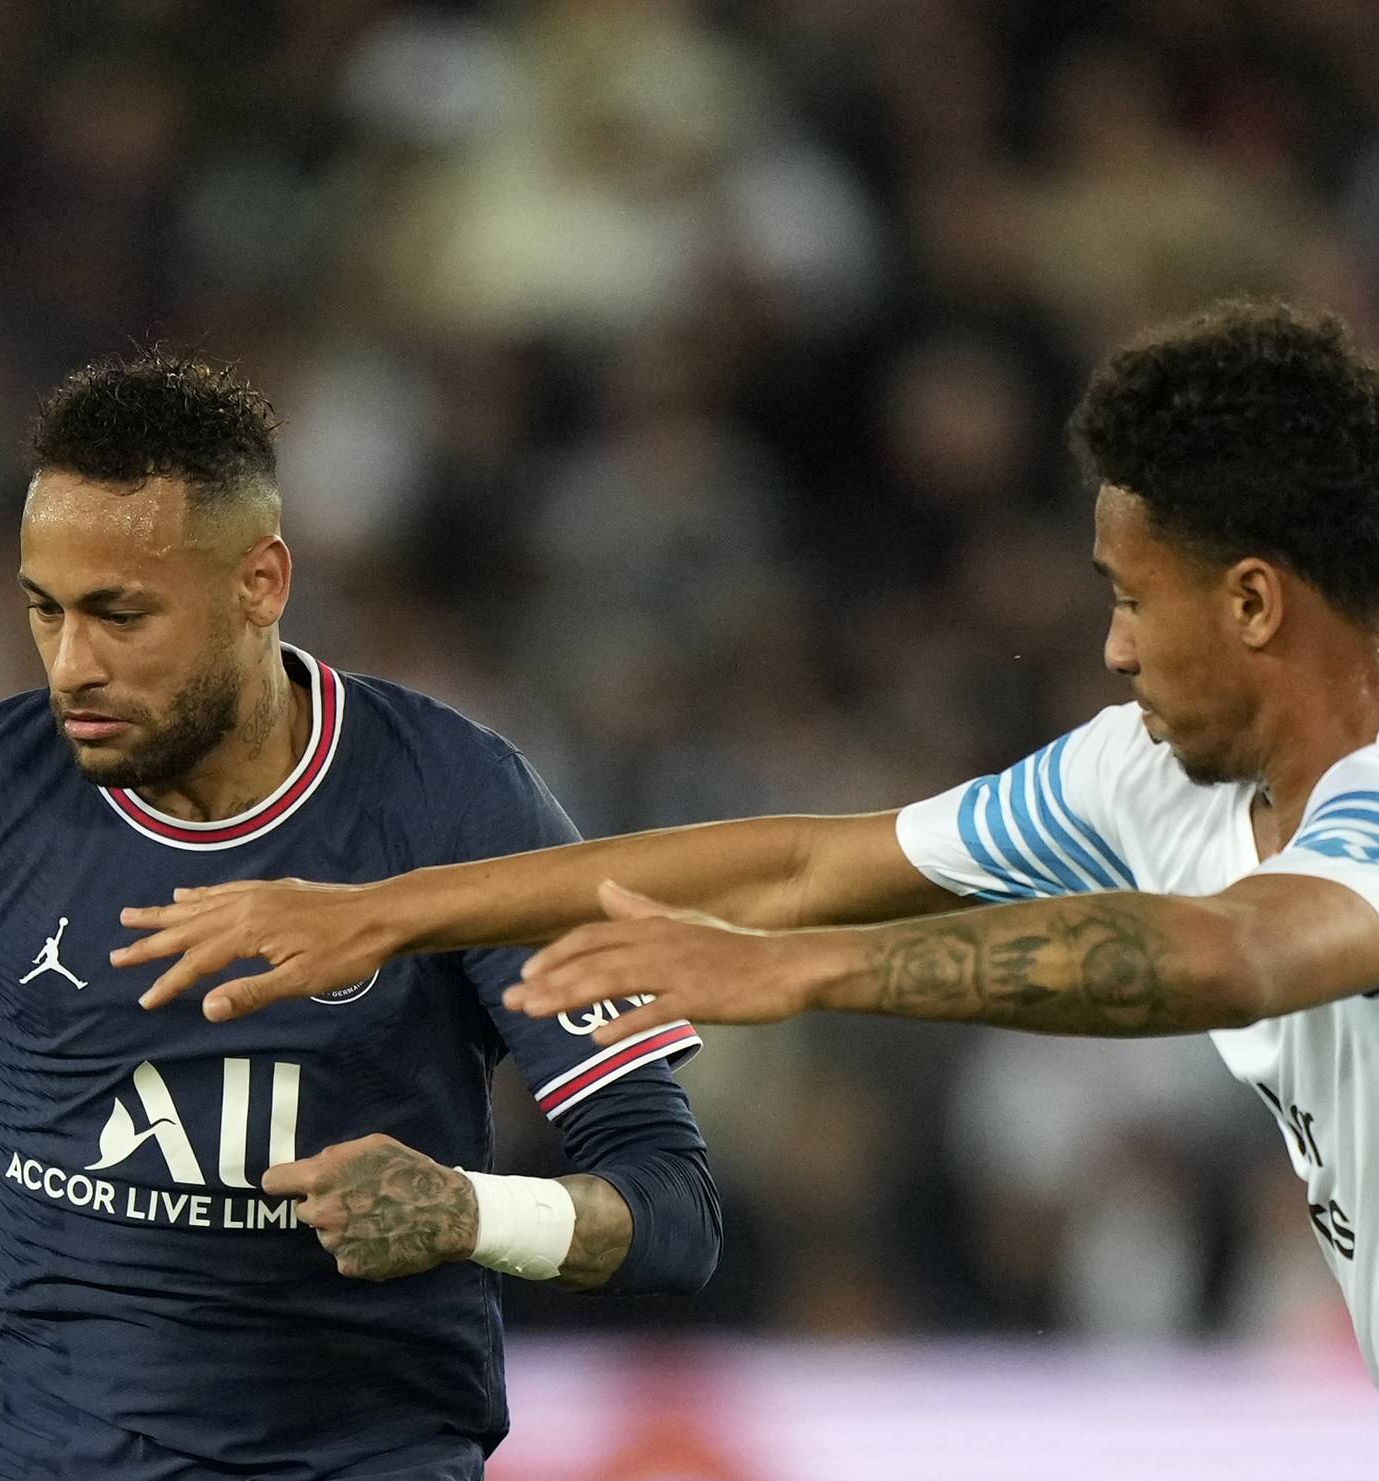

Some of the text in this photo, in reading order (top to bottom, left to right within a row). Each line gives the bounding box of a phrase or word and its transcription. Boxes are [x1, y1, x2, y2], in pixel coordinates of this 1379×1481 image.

[5, 1151, 299, 1230] ACCOR LIVE LIMI
